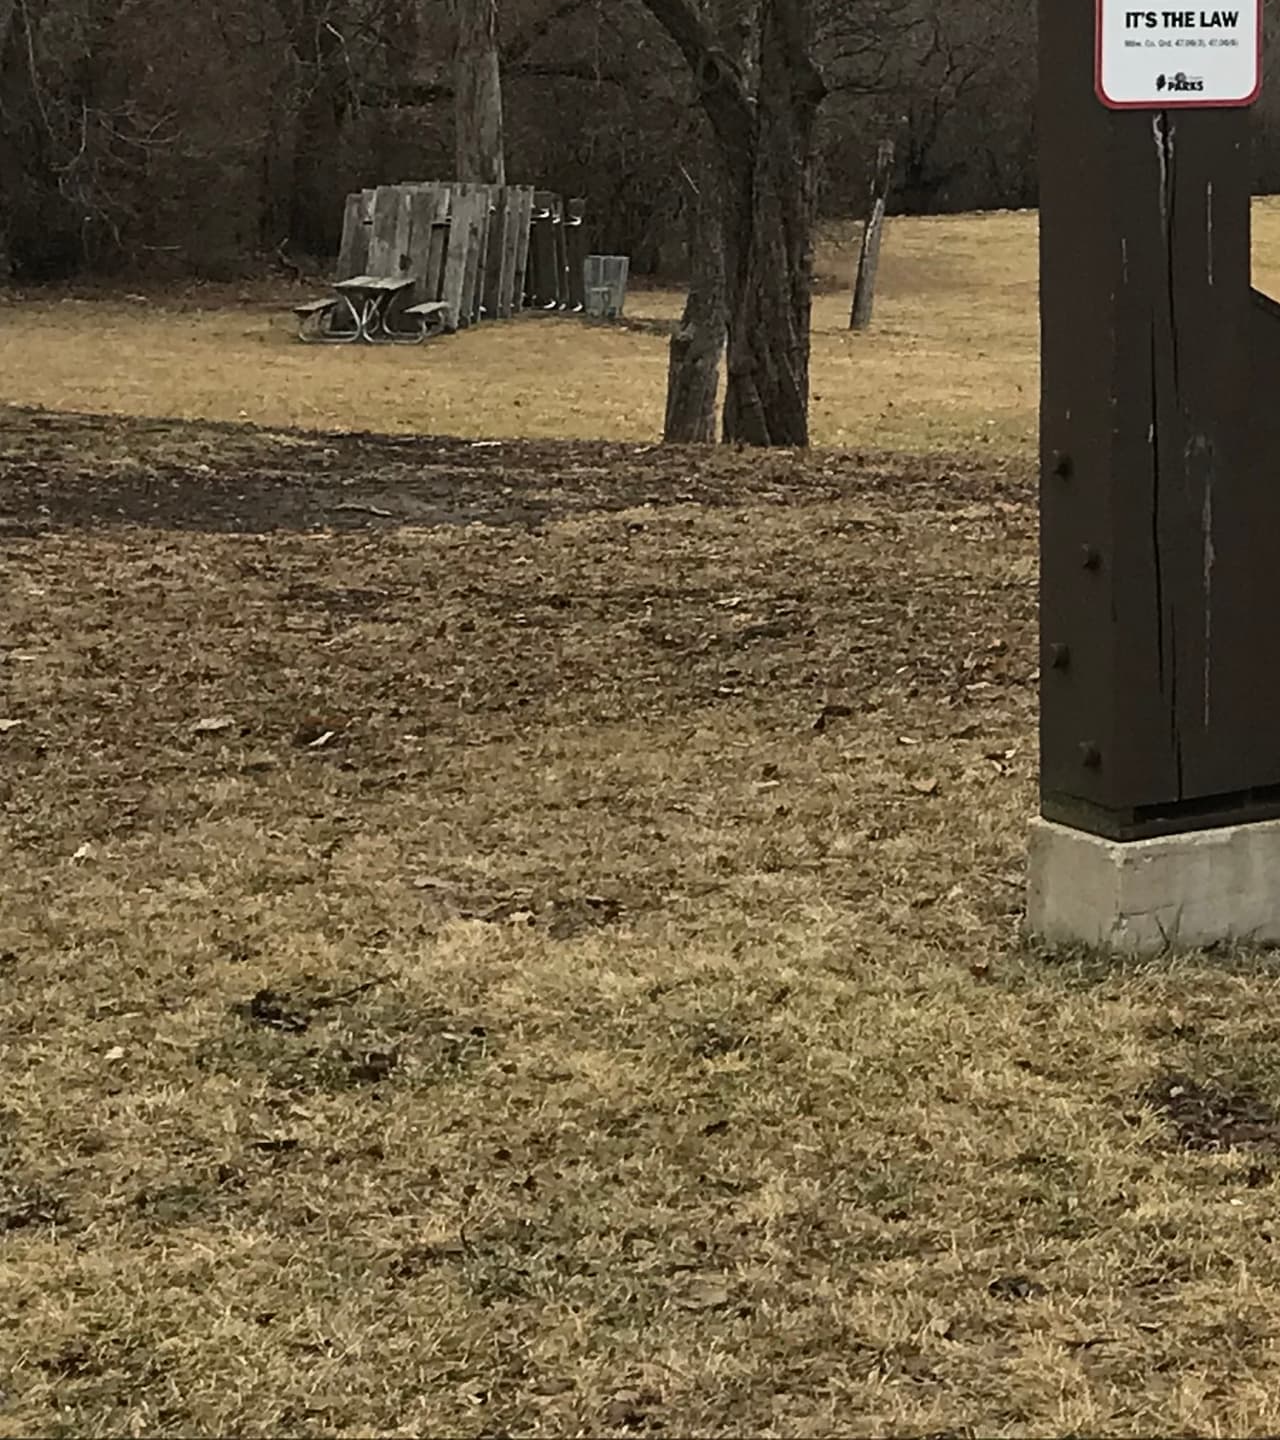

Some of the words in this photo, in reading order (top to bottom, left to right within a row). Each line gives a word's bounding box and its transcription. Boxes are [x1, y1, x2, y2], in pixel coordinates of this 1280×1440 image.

[1125, 11, 1158, 29] IT'S
[1161, 11, 1196, 28] THE
[1200, 11, 1239, 28] LAW
[1167, 80, 1204, 91] PARKS
